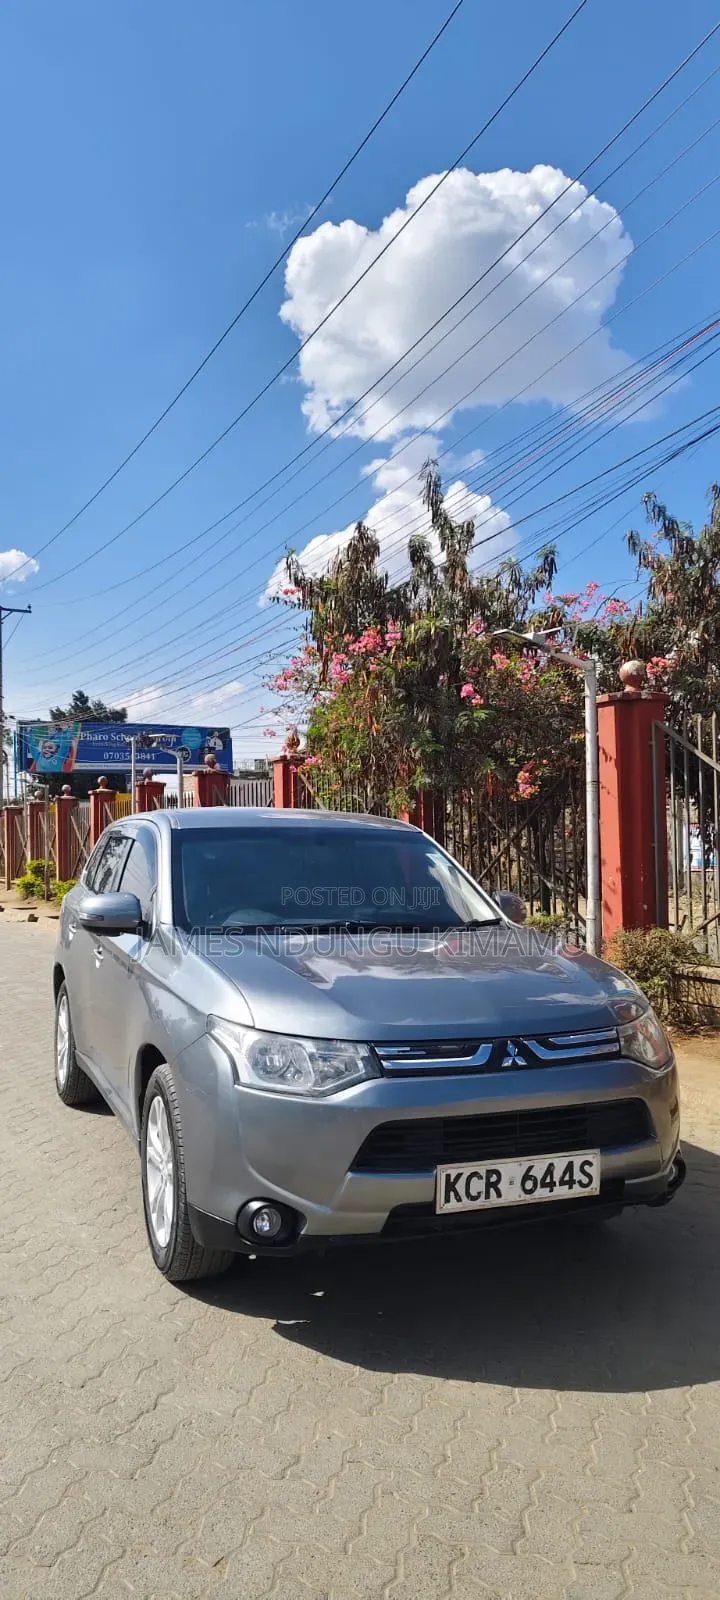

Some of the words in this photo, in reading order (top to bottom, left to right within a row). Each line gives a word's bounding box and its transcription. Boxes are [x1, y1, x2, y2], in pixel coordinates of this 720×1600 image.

[80, 731, 108, 741] Pharo
[444, 1168, 502, 1204] KCR
[520, 1160, 594, 1195] 644S
